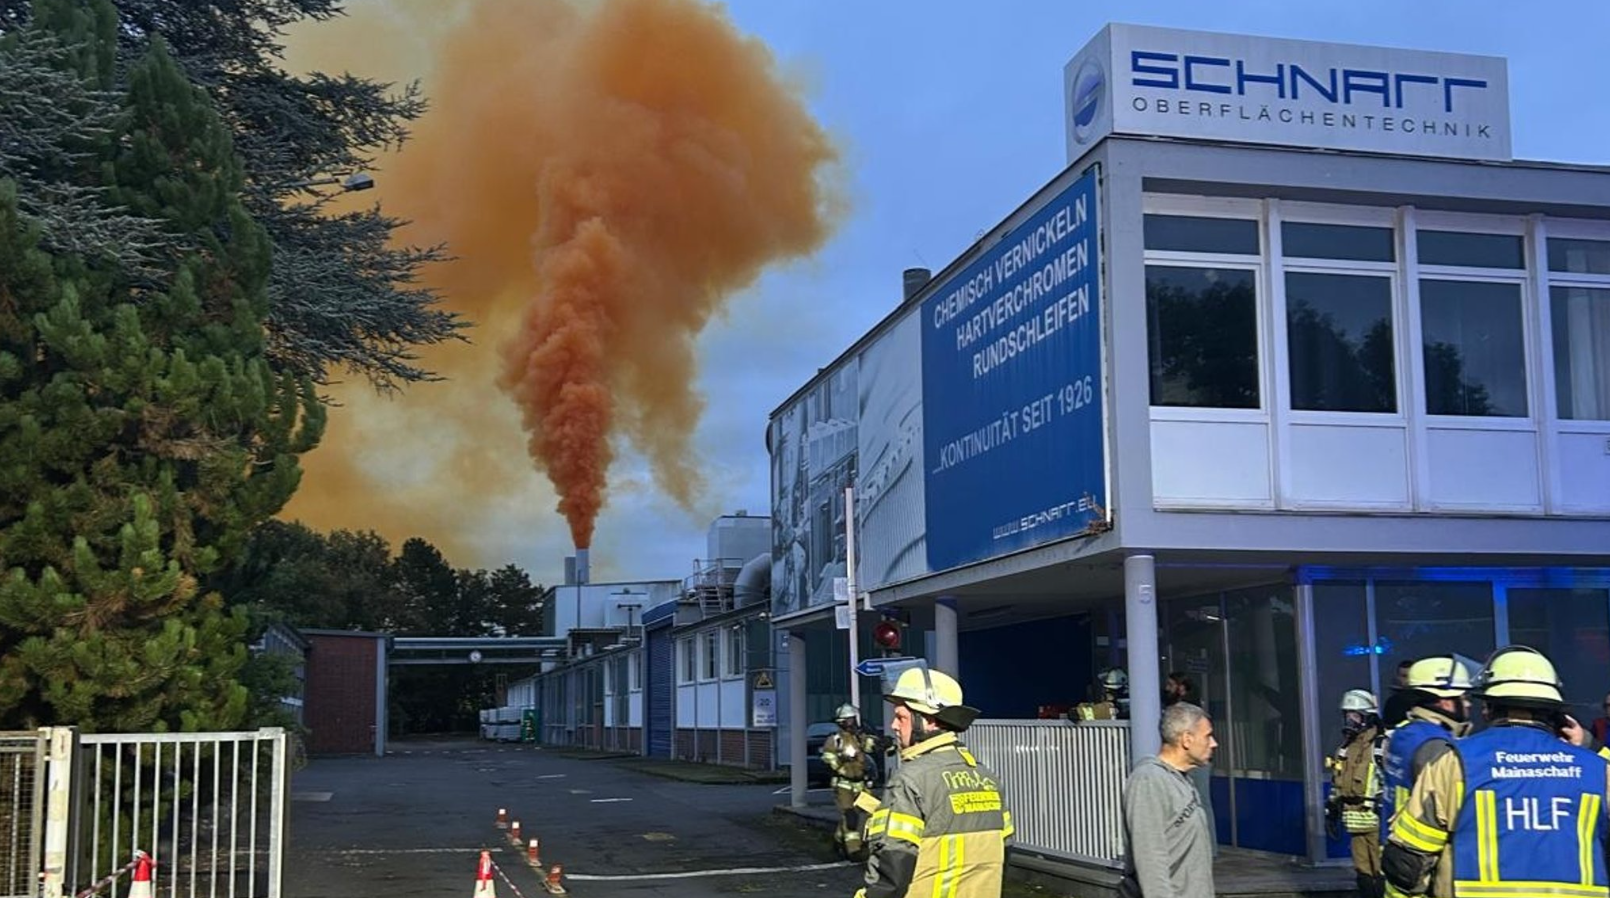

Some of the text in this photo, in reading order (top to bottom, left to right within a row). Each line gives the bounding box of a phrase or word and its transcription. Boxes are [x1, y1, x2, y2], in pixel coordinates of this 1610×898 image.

[1133, 97, 1491, 138] OBERFLÄCHENTECHNIK
[934, 193, 1088, 329] CHEMISCH VERNICKELN
[956, 239, 1088, 351] HARTVERCHROMEN
[973, 283, 1090, 379] RUNDSCHLEIFEN
[1022, 394, 1054, 434] SEIT
[1057, 375, 1093, 416] 1926
[1491, 766, 1582, 779] Mainaschaff
[1495, 752, 1575, 764] Feuerwehr
[1505, 797, 1572, 830] HLF
